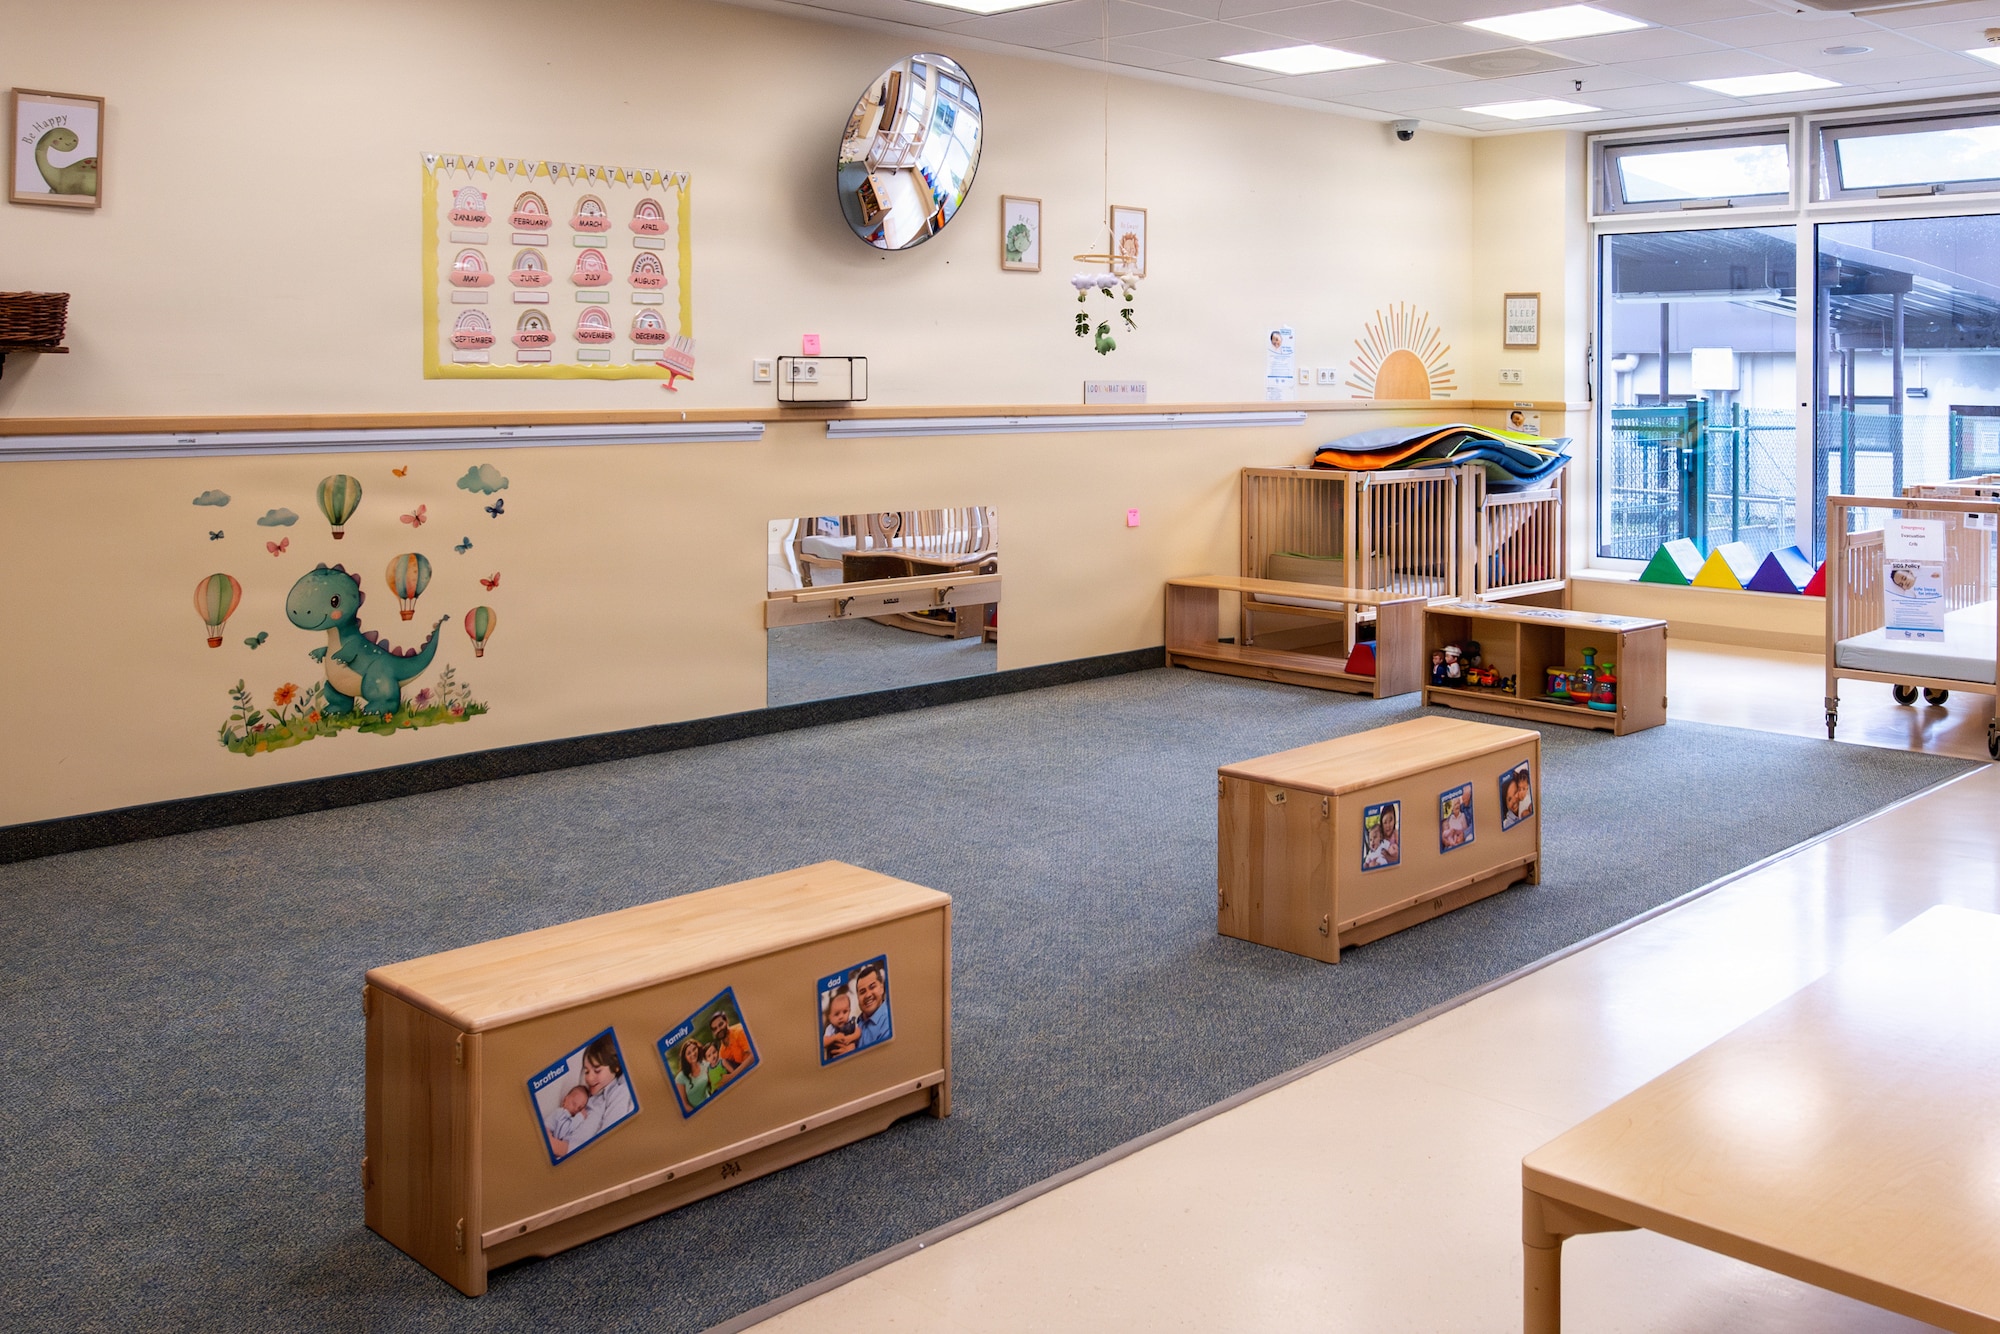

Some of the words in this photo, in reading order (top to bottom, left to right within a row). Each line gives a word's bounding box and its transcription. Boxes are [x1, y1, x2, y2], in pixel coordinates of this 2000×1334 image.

[21, 132, 36, 145] Be
[32, 114, 68, 133] Happy
[446, 158, 536, 173] HAPPY
[551, 165, 687, 183] BIRTHDAY
[453, 213, 486, 223] JANUARY
[513, 217, 549, 227] FEBRUARY
[578, 220, 603, 229] MARCH
[640, 223, 659, 231] APRIL
[462, 274, 480, 283] MAY
[519, 274, 541, 283] JUNE
[584, 273, 601, 281] JULY
[633, 277, 661, 286] AUGUST
[1509, 309, 1536, 318] SLEEP
[1508, 325, 1536, 333] DINOSAURS
[454, 335, 494, 345] SEPTEMBER
[520, 334, 550, 343] OCTOBER
[578, 331, 614, 340] NOVEMBER
[635, 332, 666, 341] DECEMBER
[827, 975, 842, 988] dad
[665, 1025, 689, 1048] family
[533, 1064, 565, 1090] brother
